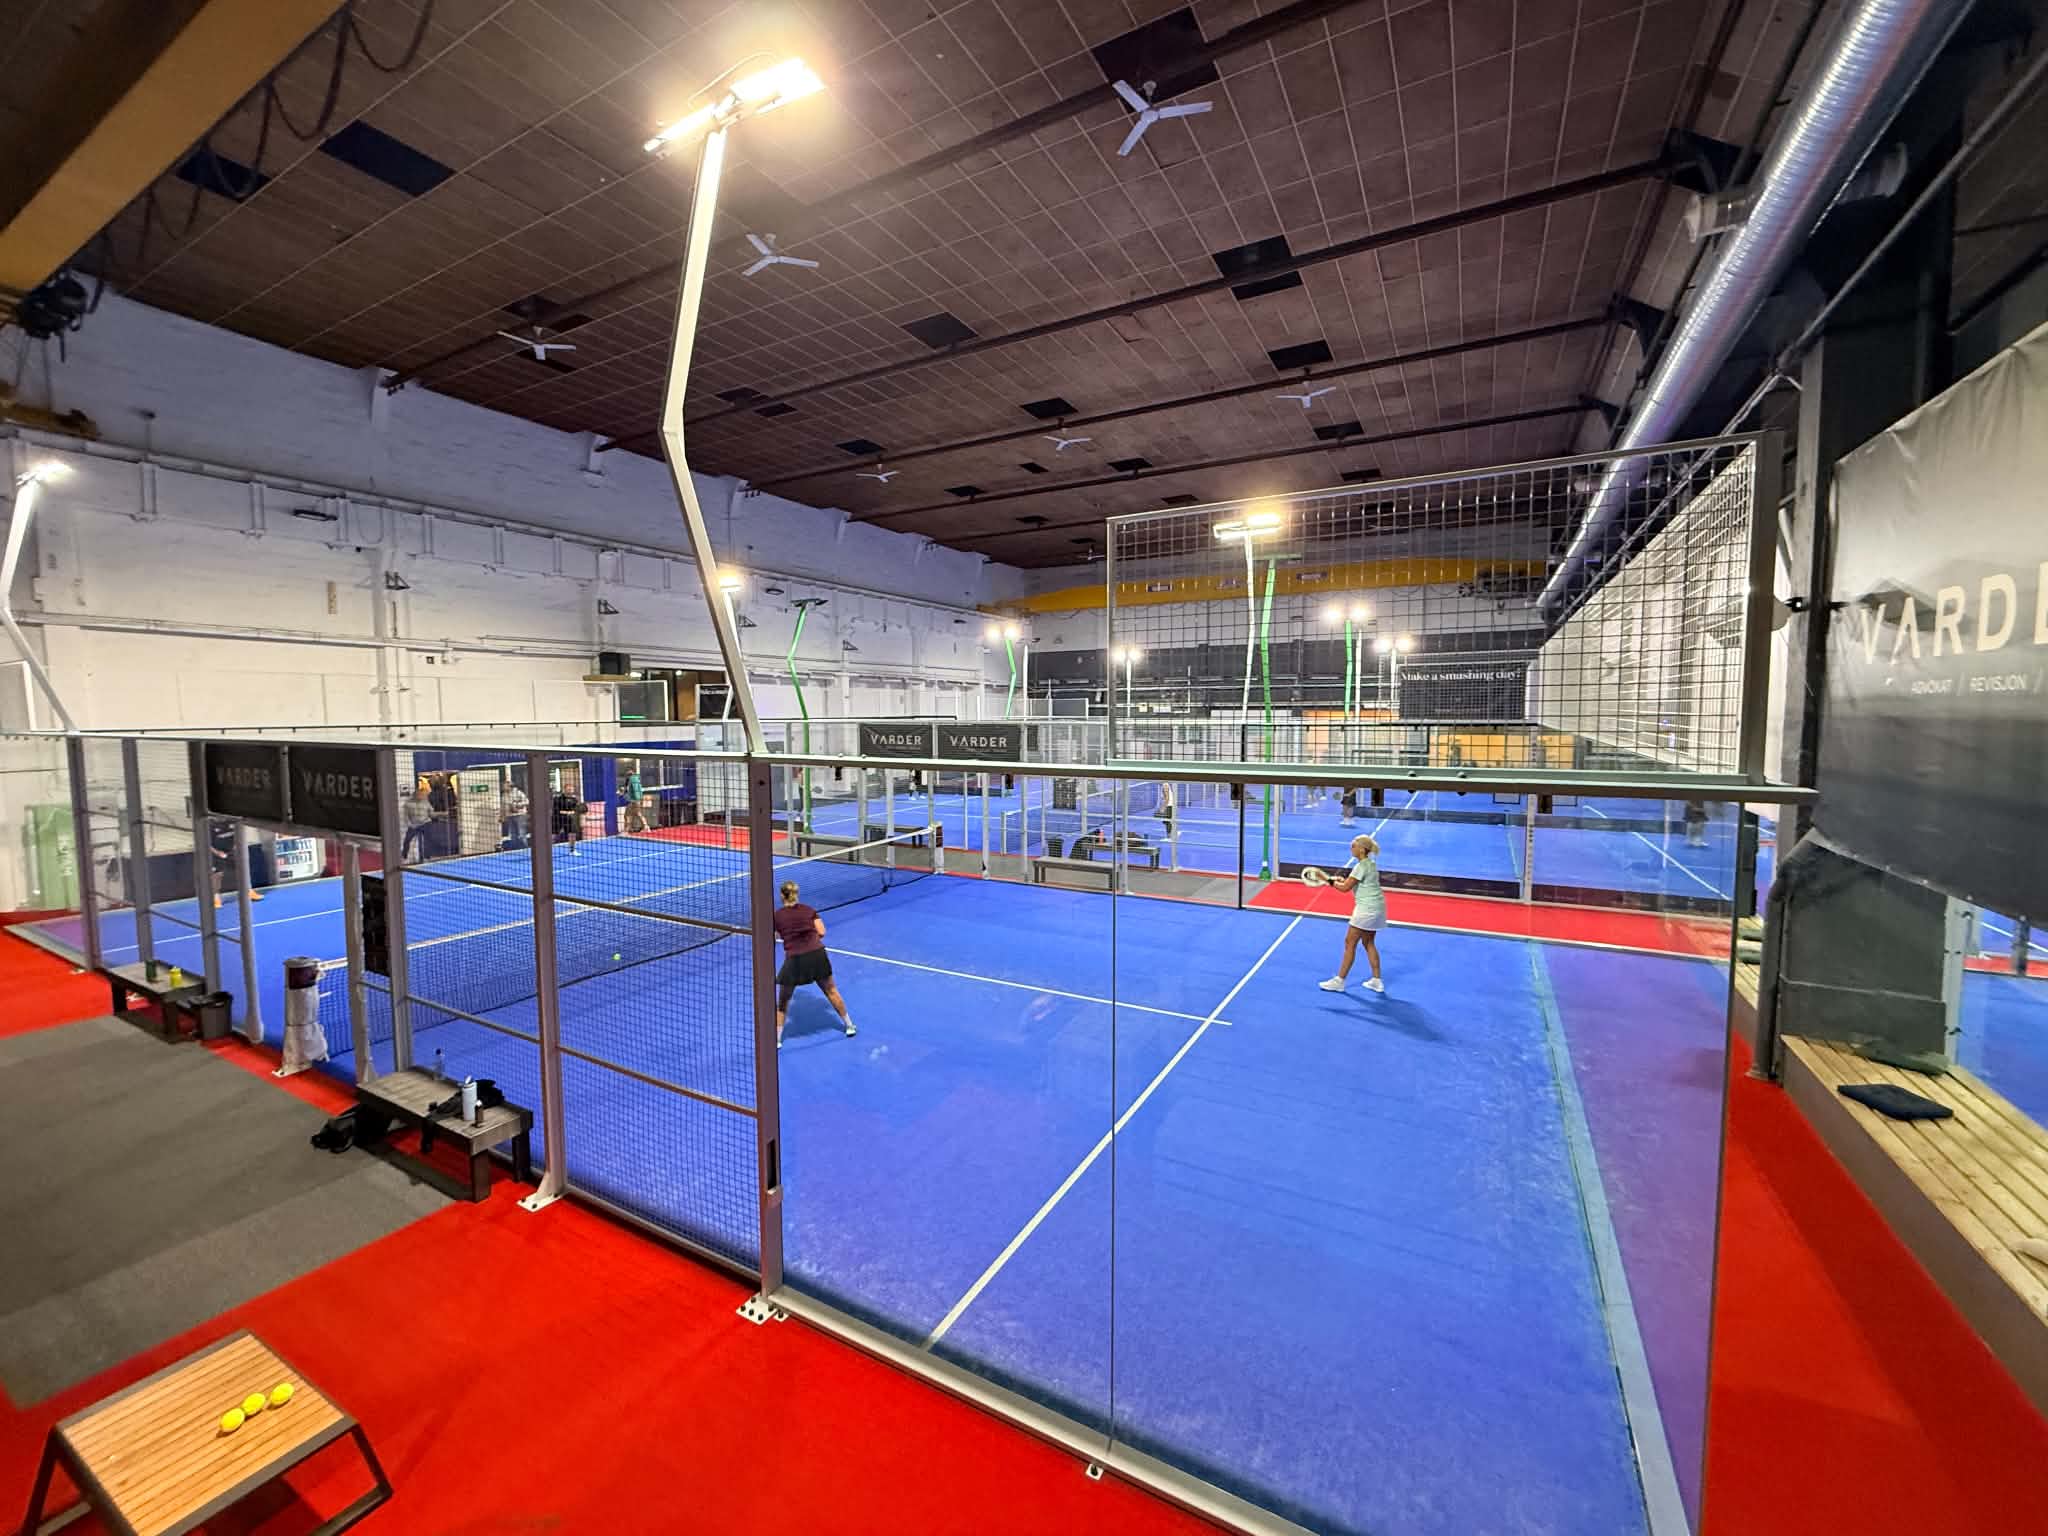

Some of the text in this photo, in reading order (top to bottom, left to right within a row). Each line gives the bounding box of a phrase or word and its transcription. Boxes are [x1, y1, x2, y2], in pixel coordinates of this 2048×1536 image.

[1440, 669, 1494, 681] smashing
[1970, 674, 2027, 693] REVISJON
[870, 734, 922, 745] VARDER
[949, 735, 1007, 748] VARDER
[216, 766, 272, 790] VARDER
[303, 771, 375, 800] VARDER
